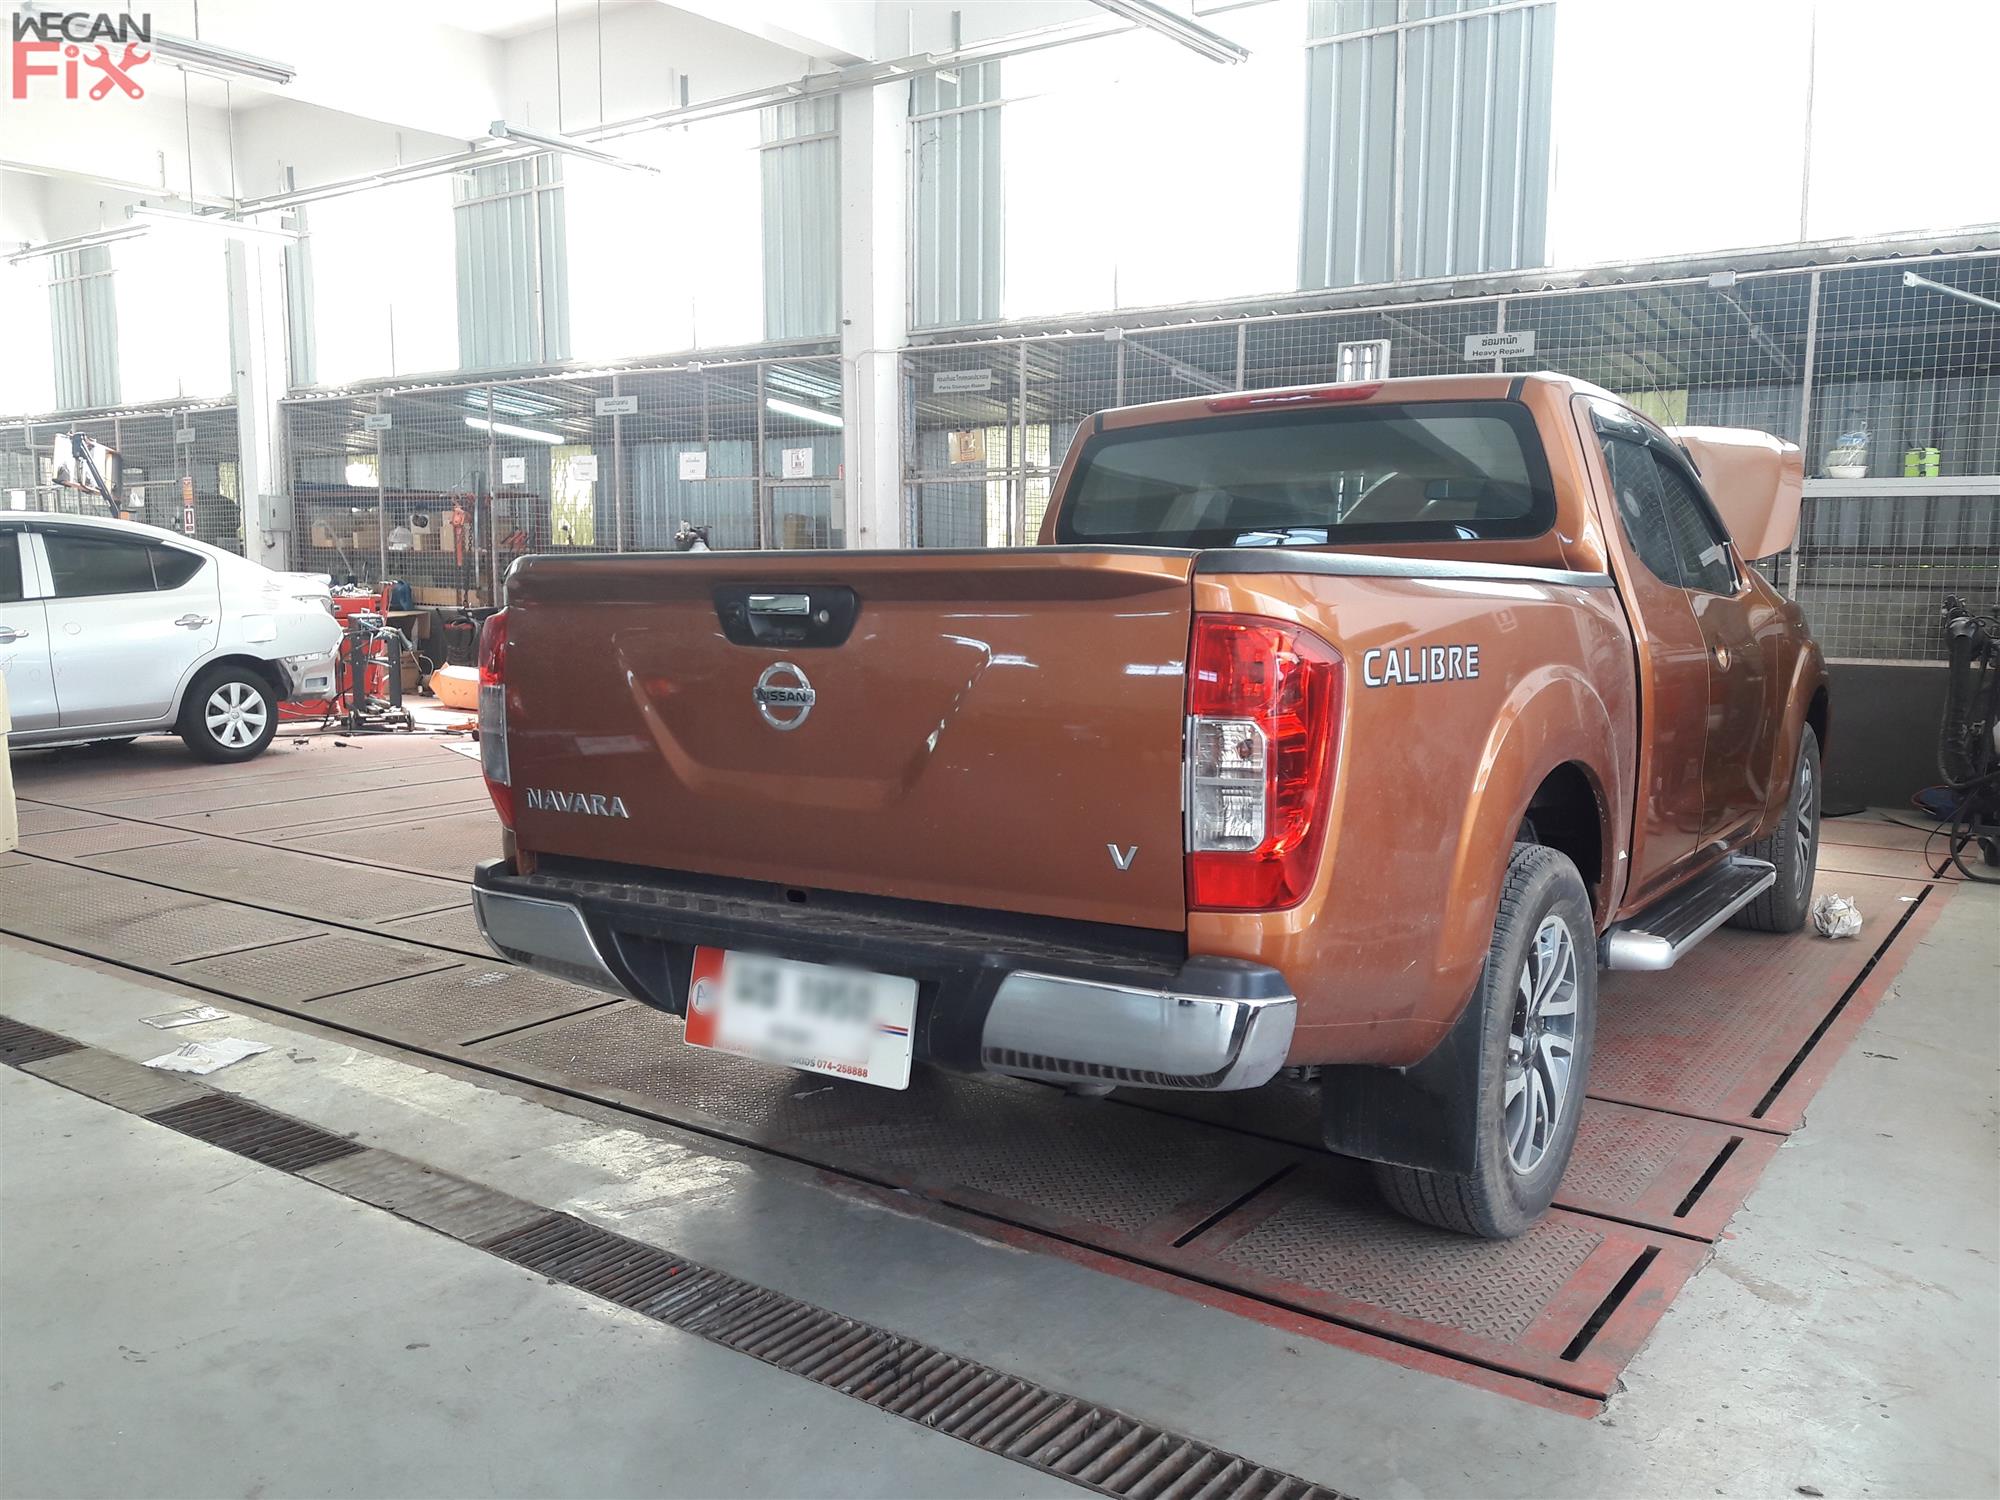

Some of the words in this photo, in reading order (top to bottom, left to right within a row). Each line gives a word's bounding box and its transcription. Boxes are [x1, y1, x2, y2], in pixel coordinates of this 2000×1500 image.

[1481, 334, 1519, 347] ซ่อมหนัก
[1472, 349, 1498, 357] Heavy
[1499, 347, 1525, 356] Repair
[1363, 645, 1479, 688] CALIBRE
[756, 689, 807, 703] NISSAN
[526, 787, 629, 819] NAVARA
[1106, 844, 1138, 870] V
[816, 1060, 869, 1079] 074-258888
